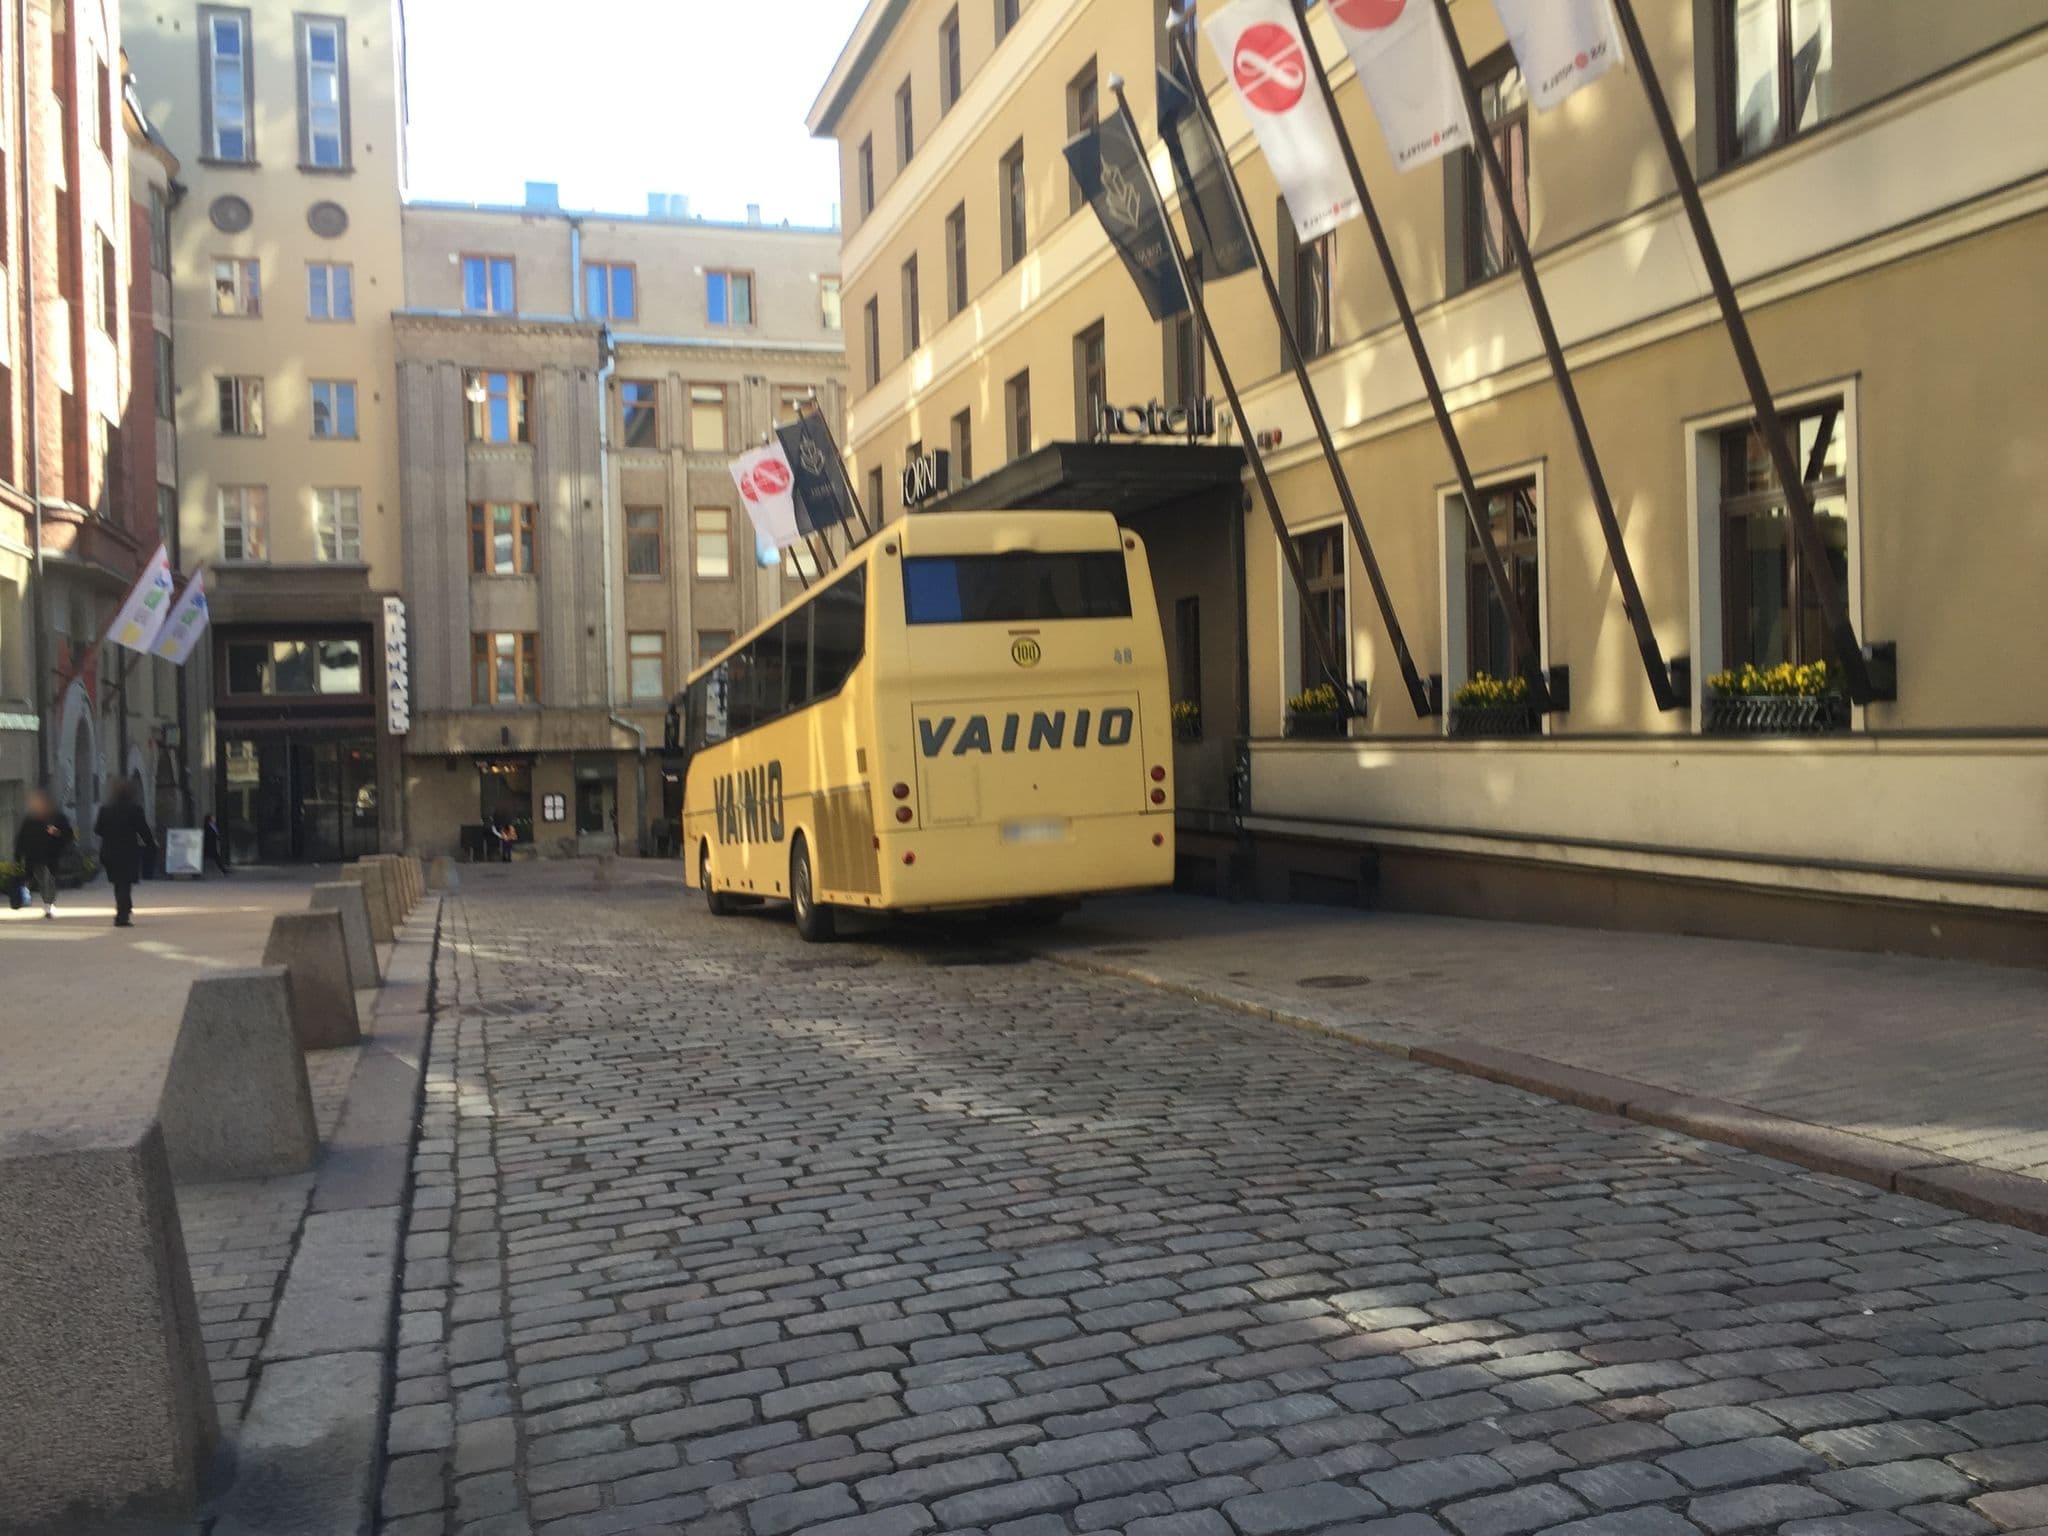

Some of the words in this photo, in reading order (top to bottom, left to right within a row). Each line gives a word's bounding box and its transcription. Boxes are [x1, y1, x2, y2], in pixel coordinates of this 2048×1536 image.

[1016, 643, 1036, 662] 100
[918, 706, 1134, 758] VAINIO
[713, 759, 785, 846] VAINIO
